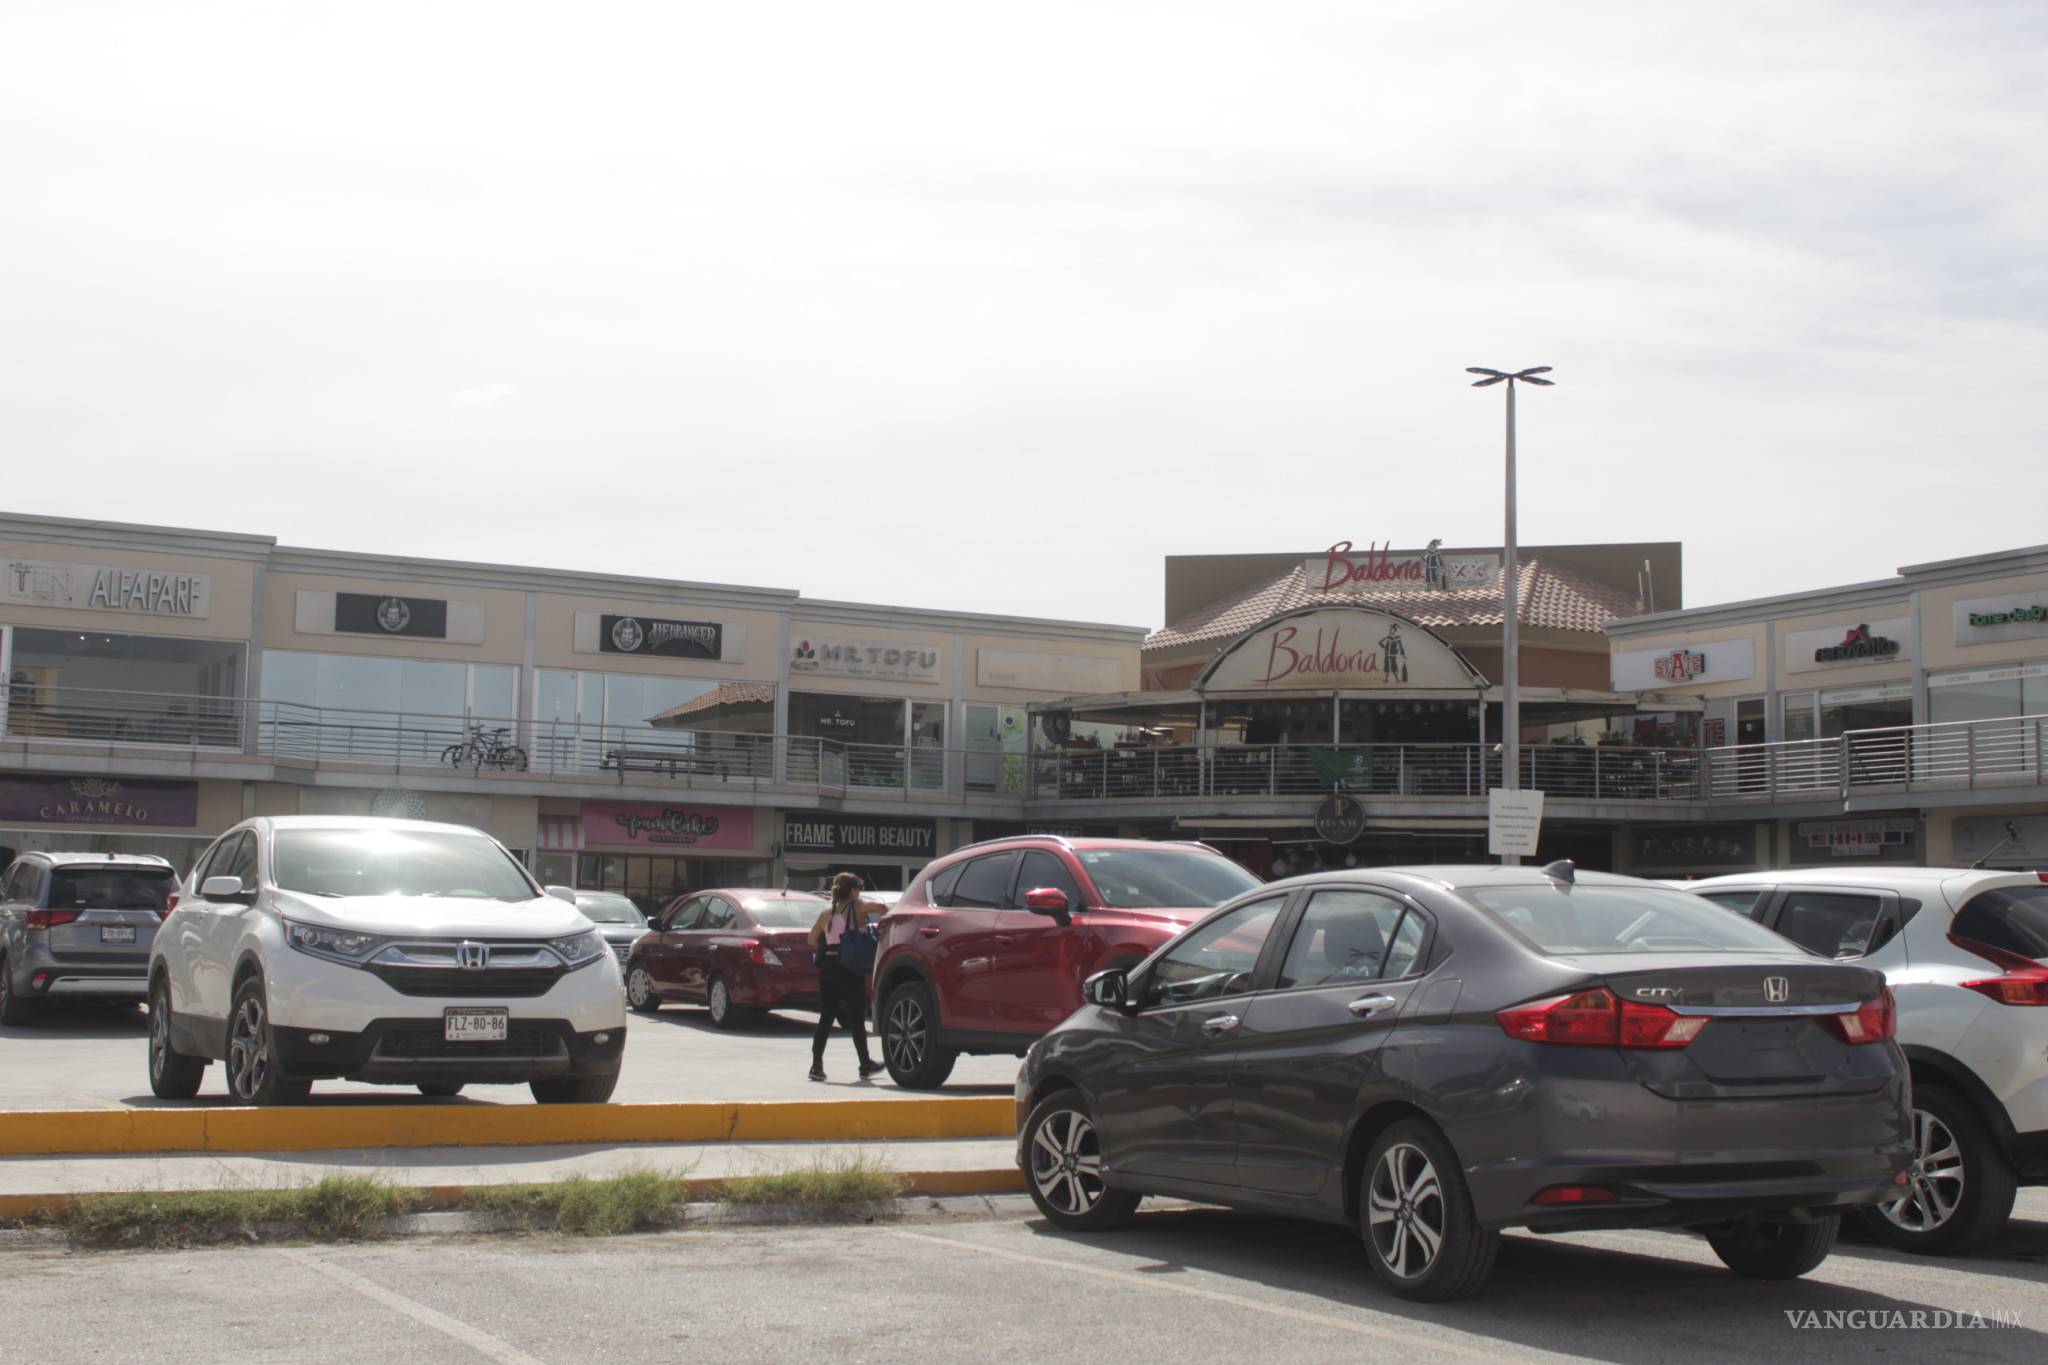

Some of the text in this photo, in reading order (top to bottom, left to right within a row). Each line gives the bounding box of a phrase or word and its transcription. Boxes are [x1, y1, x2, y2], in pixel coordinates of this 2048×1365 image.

[1312, 540, 1424, 593] Baldoria
[88, 569, 200, 614] ALFAPARF
[866, 647, 937, 669] TOFU
[1250, 626, 1378, 688] Baldoria
[835, 718, 856, 727] TOFU
[40, 801, 148, 821] CARAMELO
[785, 823, 933, 848] FRAME YOUR BEAUTY
[1636, 987, 1683, 998] CITY
[447, 1017, 506, 1031] FLZ-80-86
